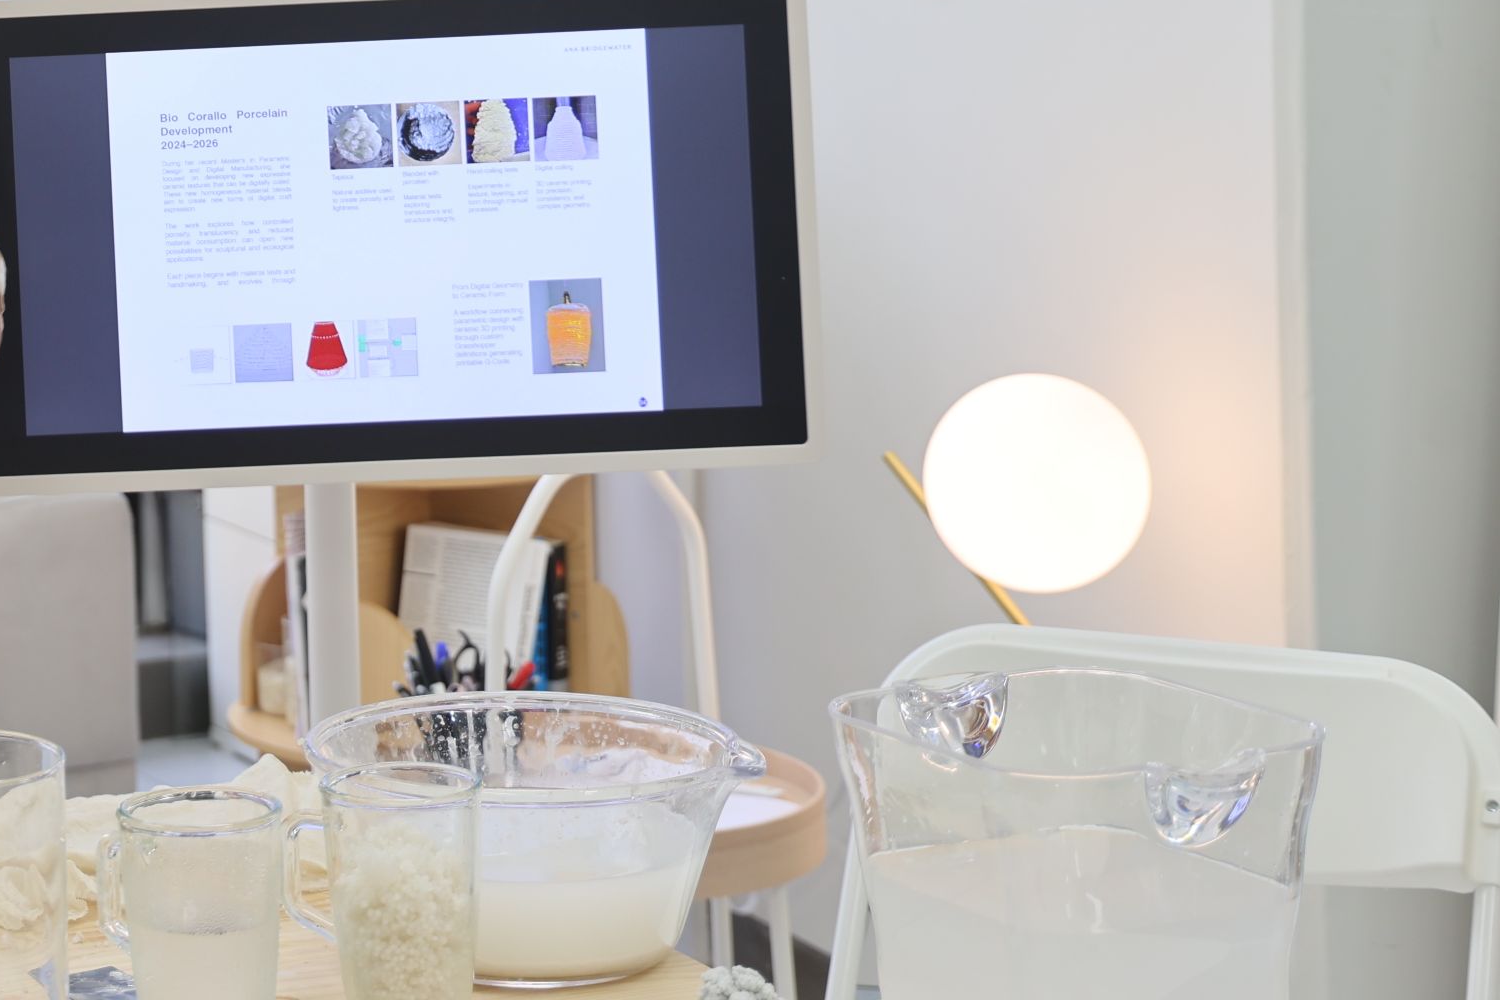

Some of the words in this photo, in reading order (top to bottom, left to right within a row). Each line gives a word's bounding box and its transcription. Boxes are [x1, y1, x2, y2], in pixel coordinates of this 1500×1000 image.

[160, 113, 179, 123] Bio
[187, 111, 227, 122] Corallo
[237, 108, 288, 119] Porcelain
[160, 125, 233, 136] Development
